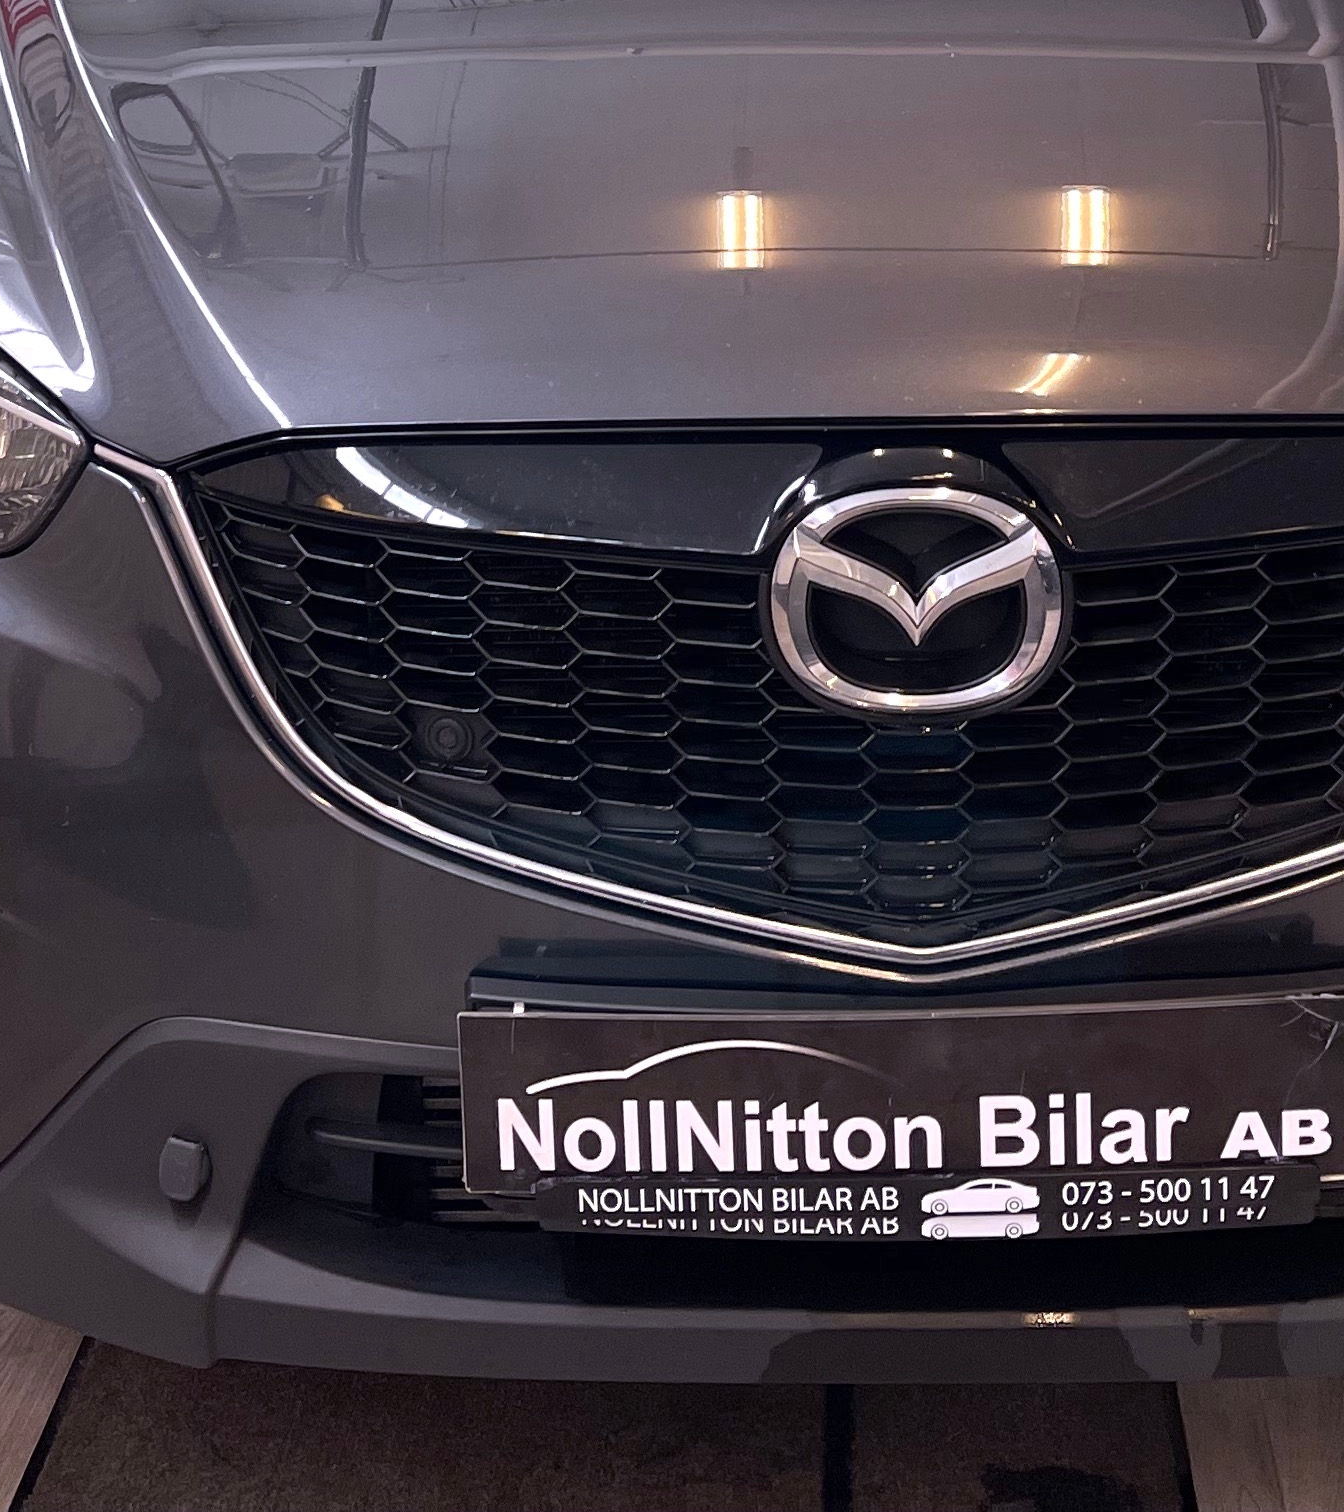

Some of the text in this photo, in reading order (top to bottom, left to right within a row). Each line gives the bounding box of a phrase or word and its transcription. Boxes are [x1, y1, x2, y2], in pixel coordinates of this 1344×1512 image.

[497, 1092, 1332, 1173] NollNitton Bilar AB
[578, 1187, 763, 1212] NOLLNITTON
[772, 1187, 853, 1212] BILAR
[859, 1186, 899, 1211] AB
[1061, 1180, 1113, 1205] 073
[1139, 1178, 1191, 1203] 500
[1200, 1176, 1229, 1201] 11
[1239, 1175, 1275, 1200] 47
